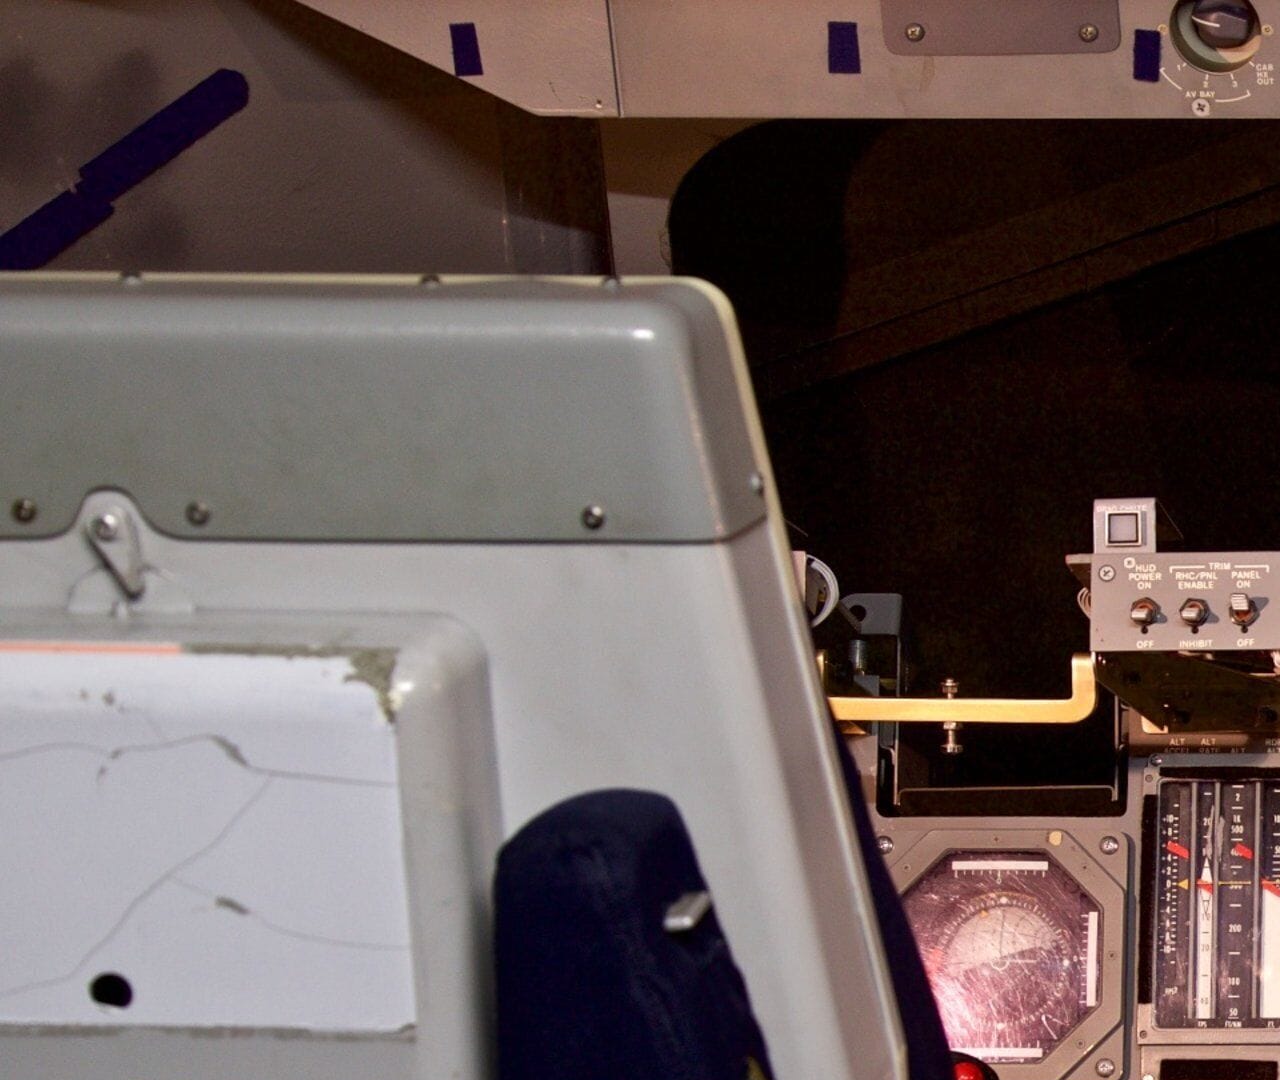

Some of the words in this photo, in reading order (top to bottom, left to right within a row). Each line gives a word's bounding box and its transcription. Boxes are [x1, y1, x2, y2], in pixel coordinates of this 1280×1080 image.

[1135, 564, 1156, 572] HUD
[1209, 562, 1231, 570] TRIM
[1128, 572, 1162, 581] POWER
[1175, 572, 1218, 580] RHC/PNL
[1231, 571, 1261, 580] PANEL
[1137, 581, 1151, 589] ON
[1178, 581, 1214, 589] ENABLE
[1236, 580, 1250, 588] ON
[1136, 640, 1155, 648] OFF
[1179, 640, 1213, 648] INHIBIT
[1237, 639, 1255, 647] OFF
[1169, 738, 1186, 746] ALT
[1200, 738, 1217, 746] ALT
